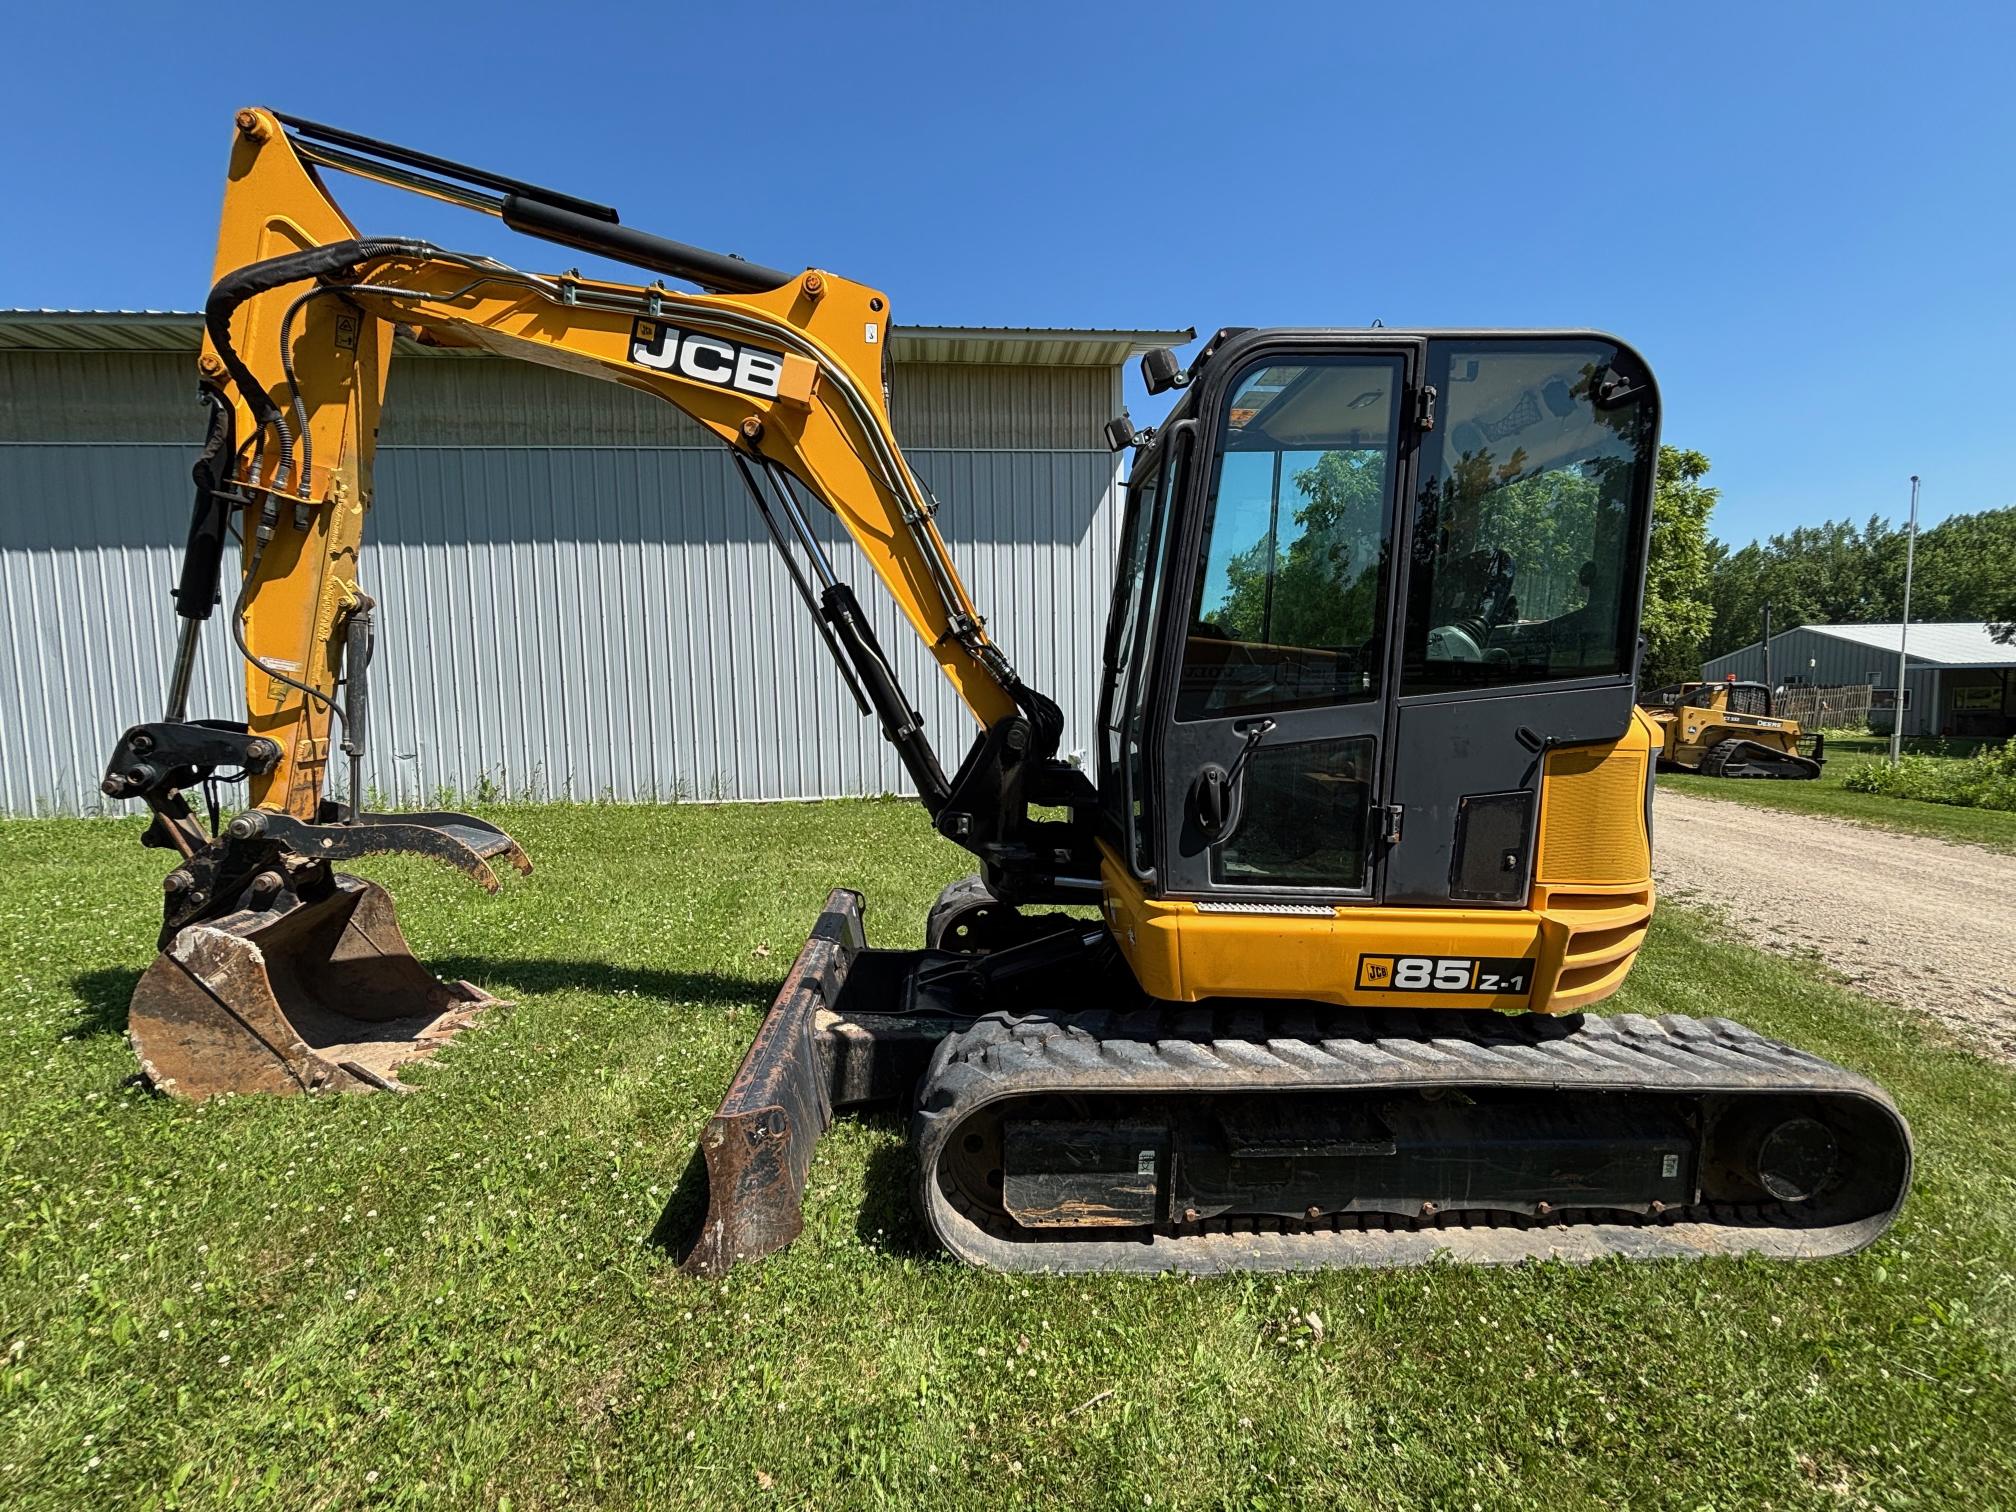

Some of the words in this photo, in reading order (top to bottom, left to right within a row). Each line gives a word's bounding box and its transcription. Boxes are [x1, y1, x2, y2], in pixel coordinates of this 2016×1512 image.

[633, 327, 783, 397] JCB
[1369, 965, 1388, 979] JCB
[1394, 958, 1471, 990] 85
